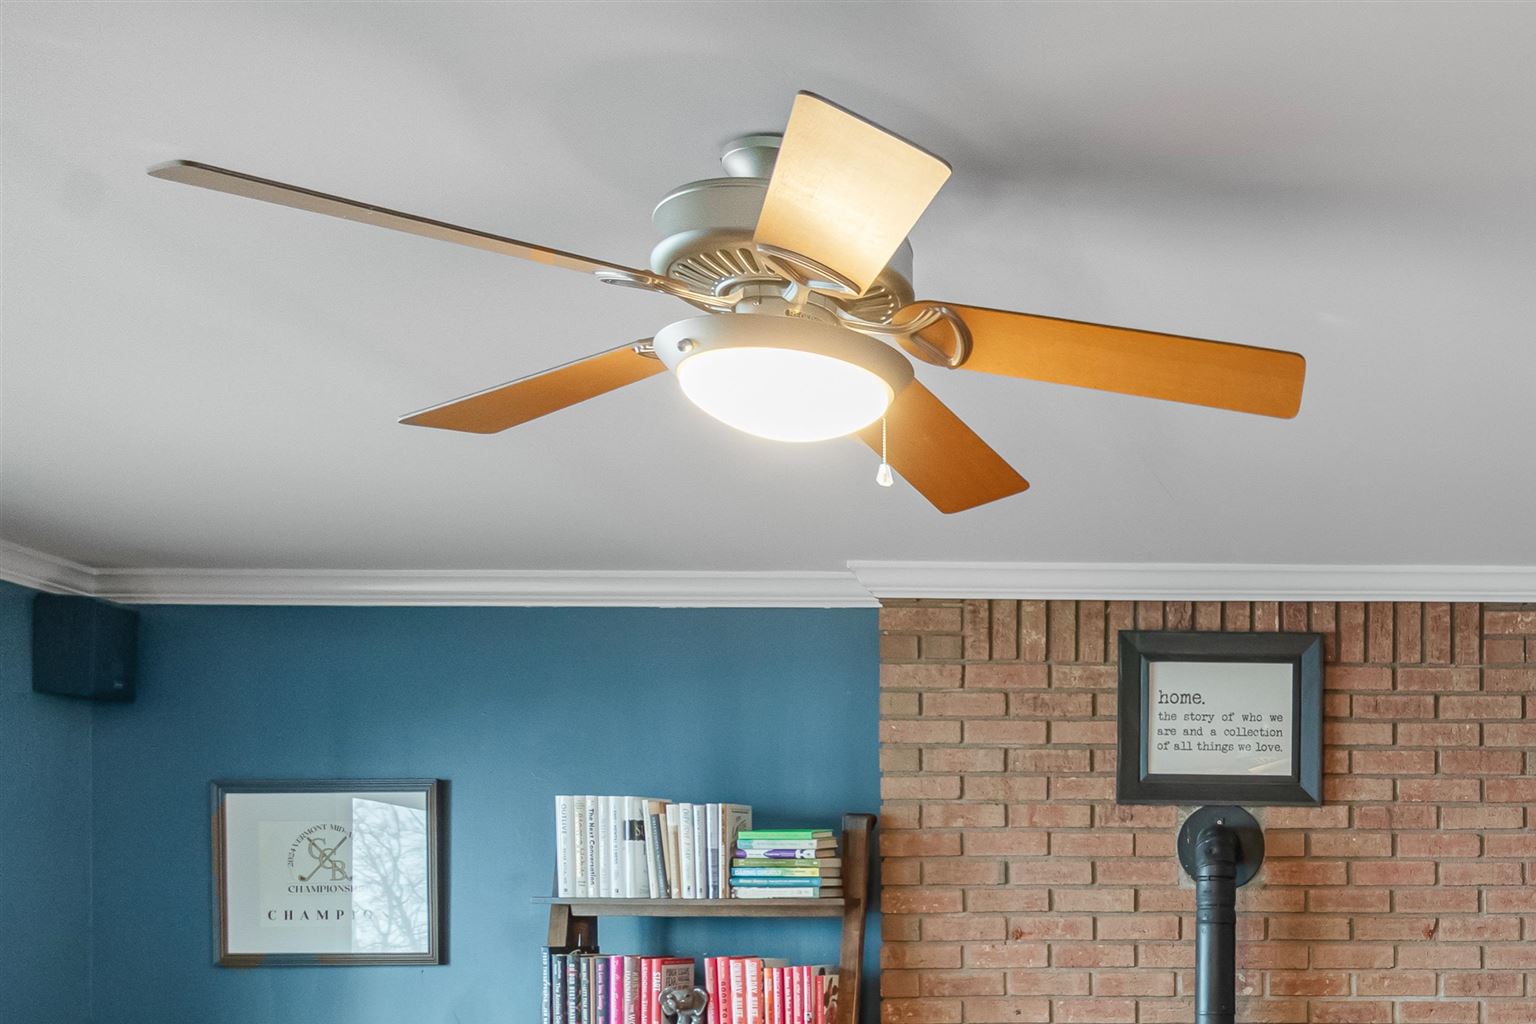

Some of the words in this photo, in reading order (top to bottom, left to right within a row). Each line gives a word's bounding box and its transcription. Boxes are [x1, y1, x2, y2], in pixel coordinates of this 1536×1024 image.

[1158, 690, 1206, 705] home.
[1158, 712, 1177, 722] the
[1183, 713, 1215, 724] story
[1221, 712, 1235, 722] of
[1241, 712, 1263, 722] who
[1269, 714, 1284, 722] we
[1157, 727, 1177, 736] are
[1183, 726, 1204, 737] and
[1210, 728, 1217, 737] a
[1223, 727, 1284, 737] collection
[1156, 741, 1170, 751] of
[1173, 741, 1193, 751] all
[1197, 742, 1235, 754] things
[1238, 743, 1252, 752] we
[1255, 742, 1284, 752] love.
[292, 823, 328, 848] VERMONT
[652, 972, 660, 992] START
[722, 1008, 728, 1019] TO
